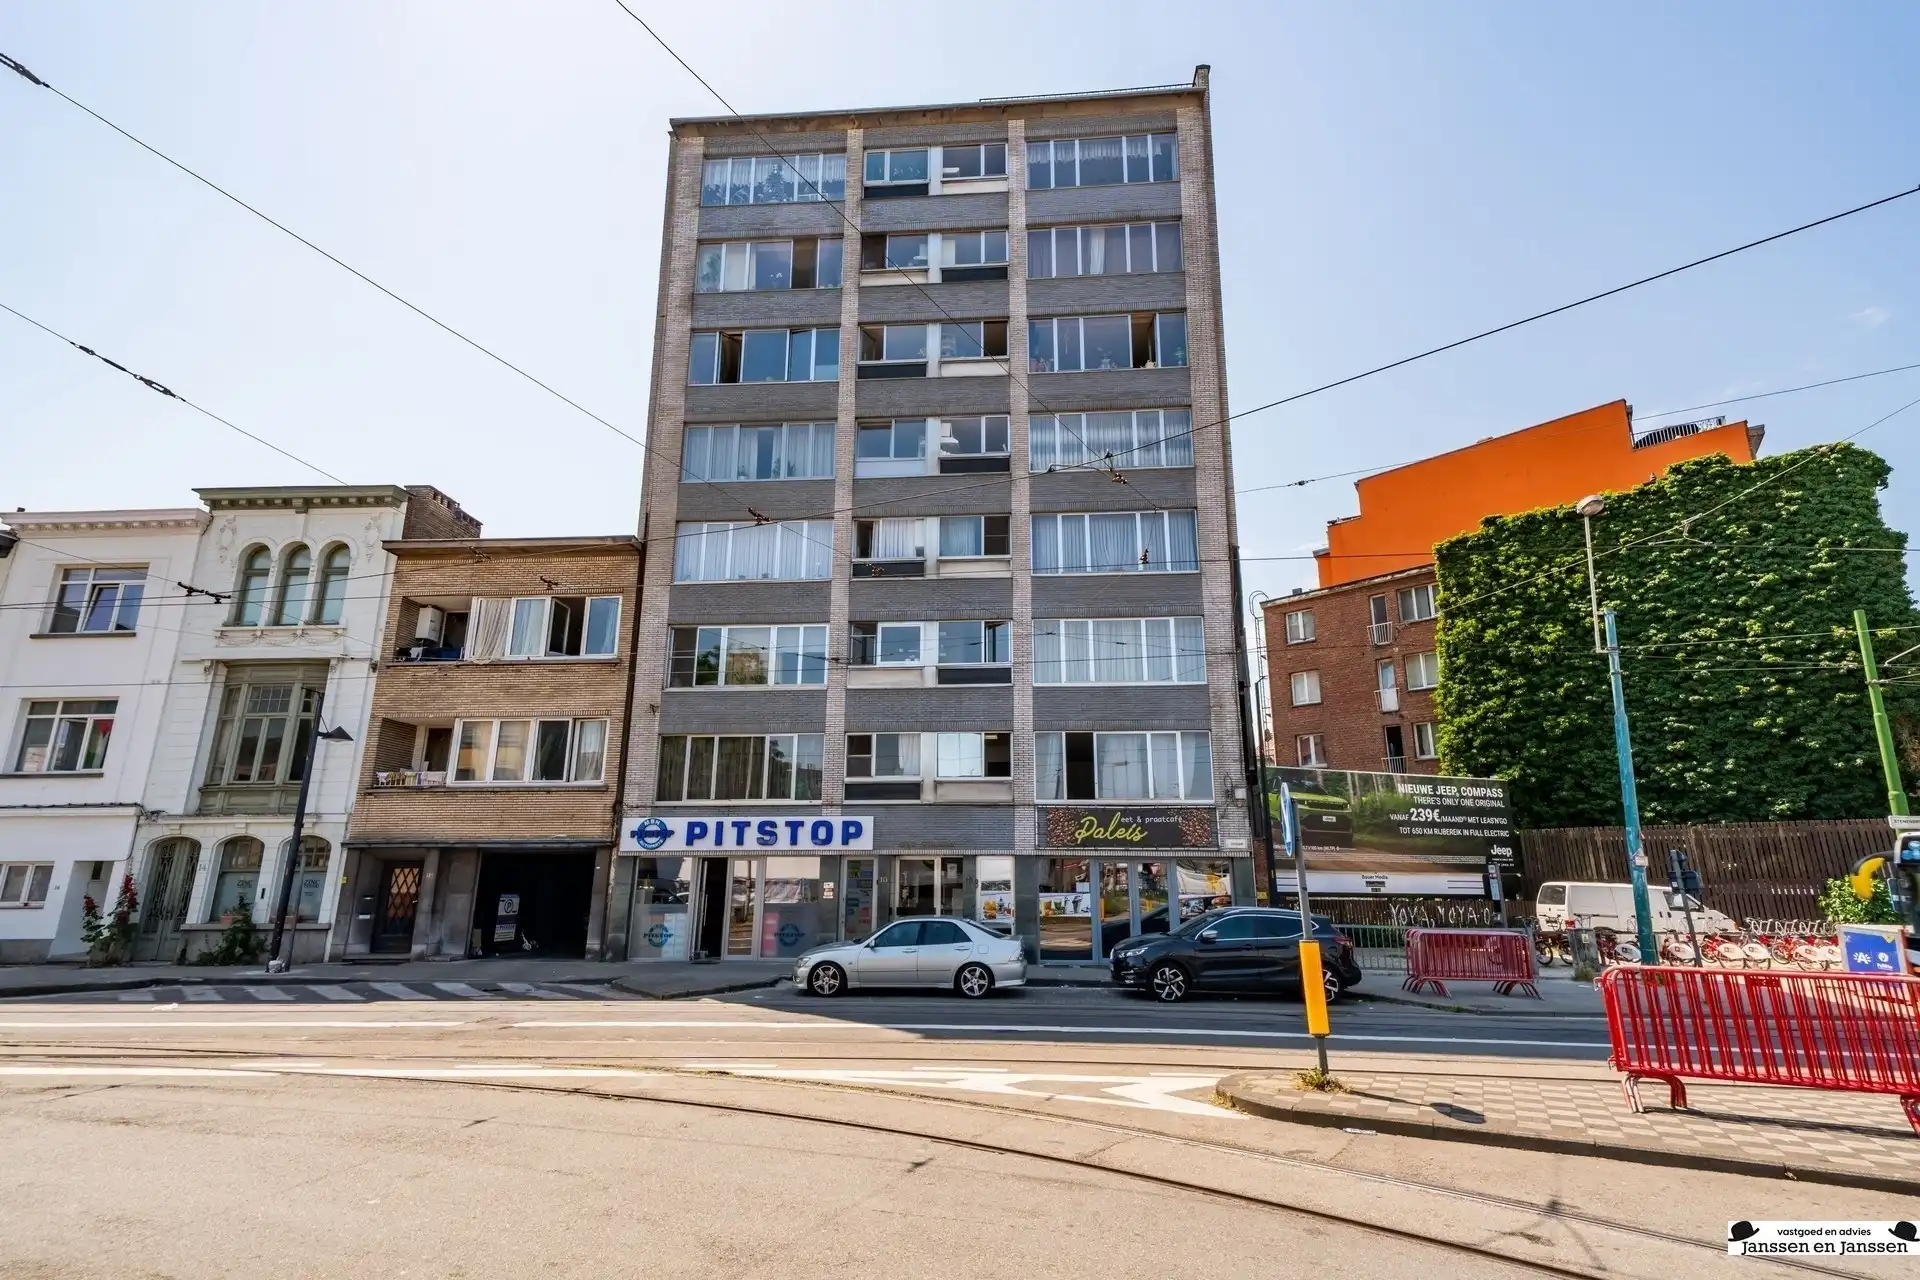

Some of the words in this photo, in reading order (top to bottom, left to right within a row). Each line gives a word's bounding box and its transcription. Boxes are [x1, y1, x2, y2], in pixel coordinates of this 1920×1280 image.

[1398, 784, 1433, 795] NIEUWE
[1461, 786, 1503, 798] COMPASS
[1413, 796, 1441, 805] THERE'S
[1442, 797, 1459, 806] ONLY
[1460, 798, 1474, 807] ONE
[1475, 799, 1505, 808] ORIGINAL
[1145, 815, 1183, 824] praatcafé
[1389, 813, 1409, 821] VANAF
[685, 820, 863, 846] PITSTOP
[1075, 811, 1148, 844] Paleis
[1412, 827, 1423, 835] 650
[1434, 828, 1462, 836] RIJBEREIK
[1470, 829, 1484, 837] FULL
[1484, 829, 1510, 838] ELECTRIC
[1490, 844, 1513, 857] Jeep
